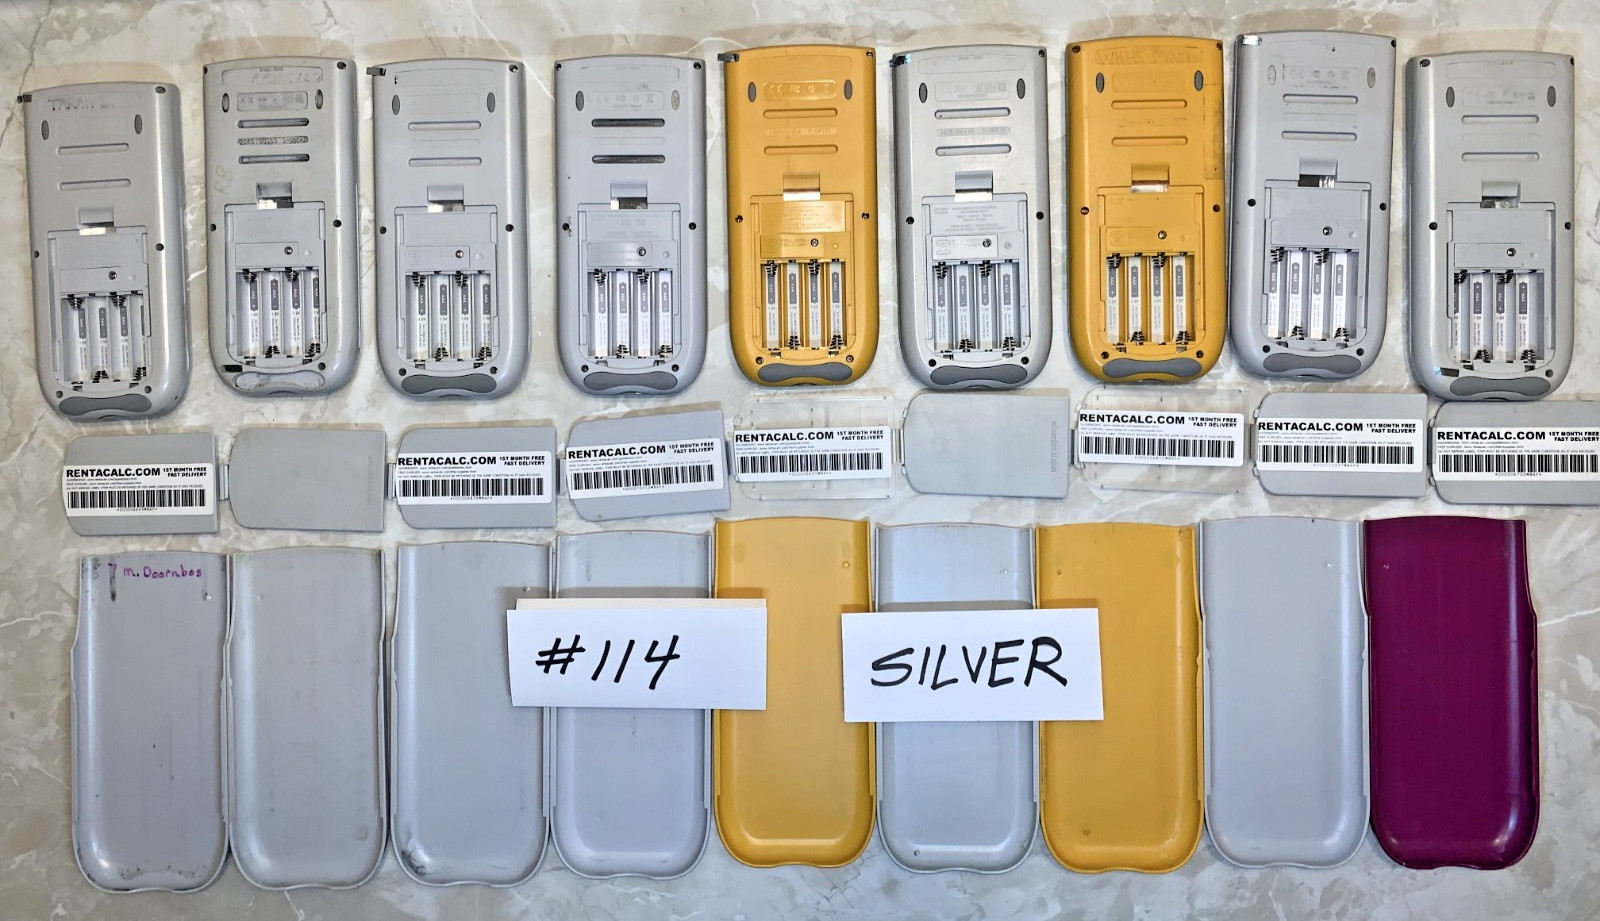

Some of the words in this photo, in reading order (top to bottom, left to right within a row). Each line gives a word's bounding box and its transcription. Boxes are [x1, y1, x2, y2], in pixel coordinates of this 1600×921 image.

[1079, 413, 1185, 425] RENTACALC.COM
[1258, 422, 1363, 432] RENTACALC.COM
[735, 431, 834, 443] RENTACALC.COM
[1437, 431, 1545, 440] RENTACALC.COM
[568, 445, 666, 459] RENTACALC.COM
[398, 456, 496, 466] RENTACALC.COM
[66, 467, 160, 477] RENTACALC.COM
[535, 635, 680, 690] #114
[870, 636, 1068, 690] SILVER
